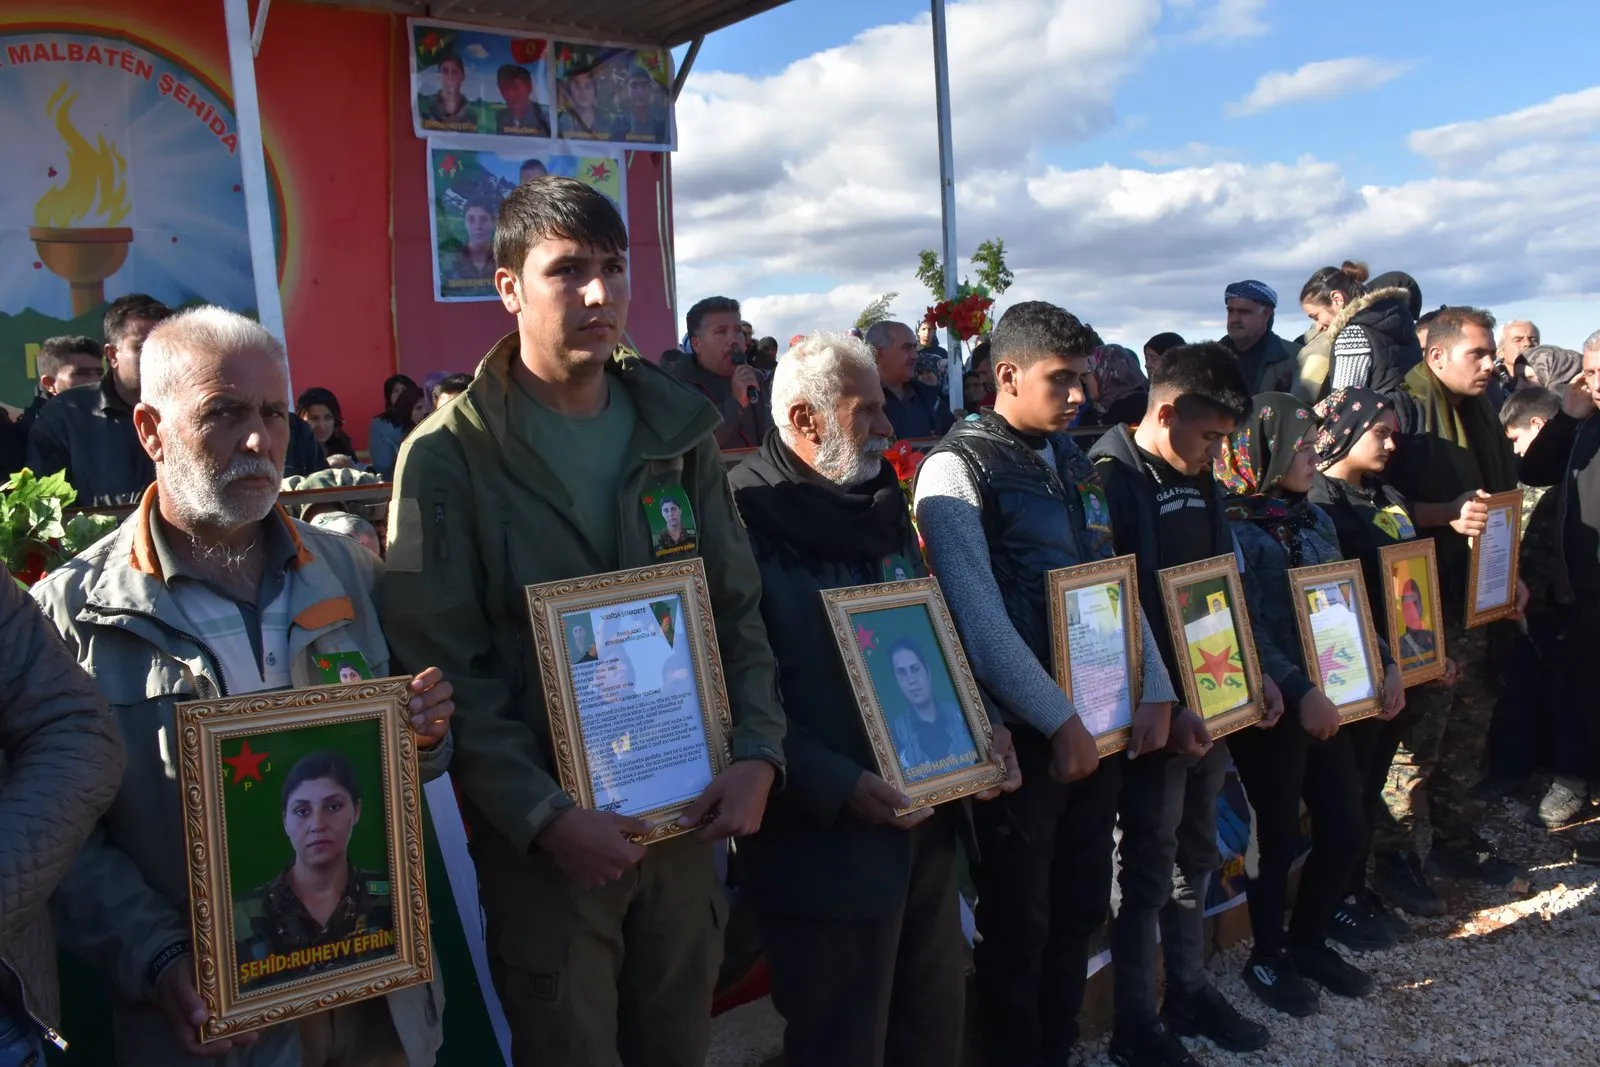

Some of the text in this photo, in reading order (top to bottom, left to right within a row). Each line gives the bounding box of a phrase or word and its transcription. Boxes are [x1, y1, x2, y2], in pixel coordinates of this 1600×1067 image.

[7, 42, 153, 80] MALBATÊN
[244, 781, 252, 791] P
[240, 940, 351, 984] ŞEHÎD:RUHEYV
